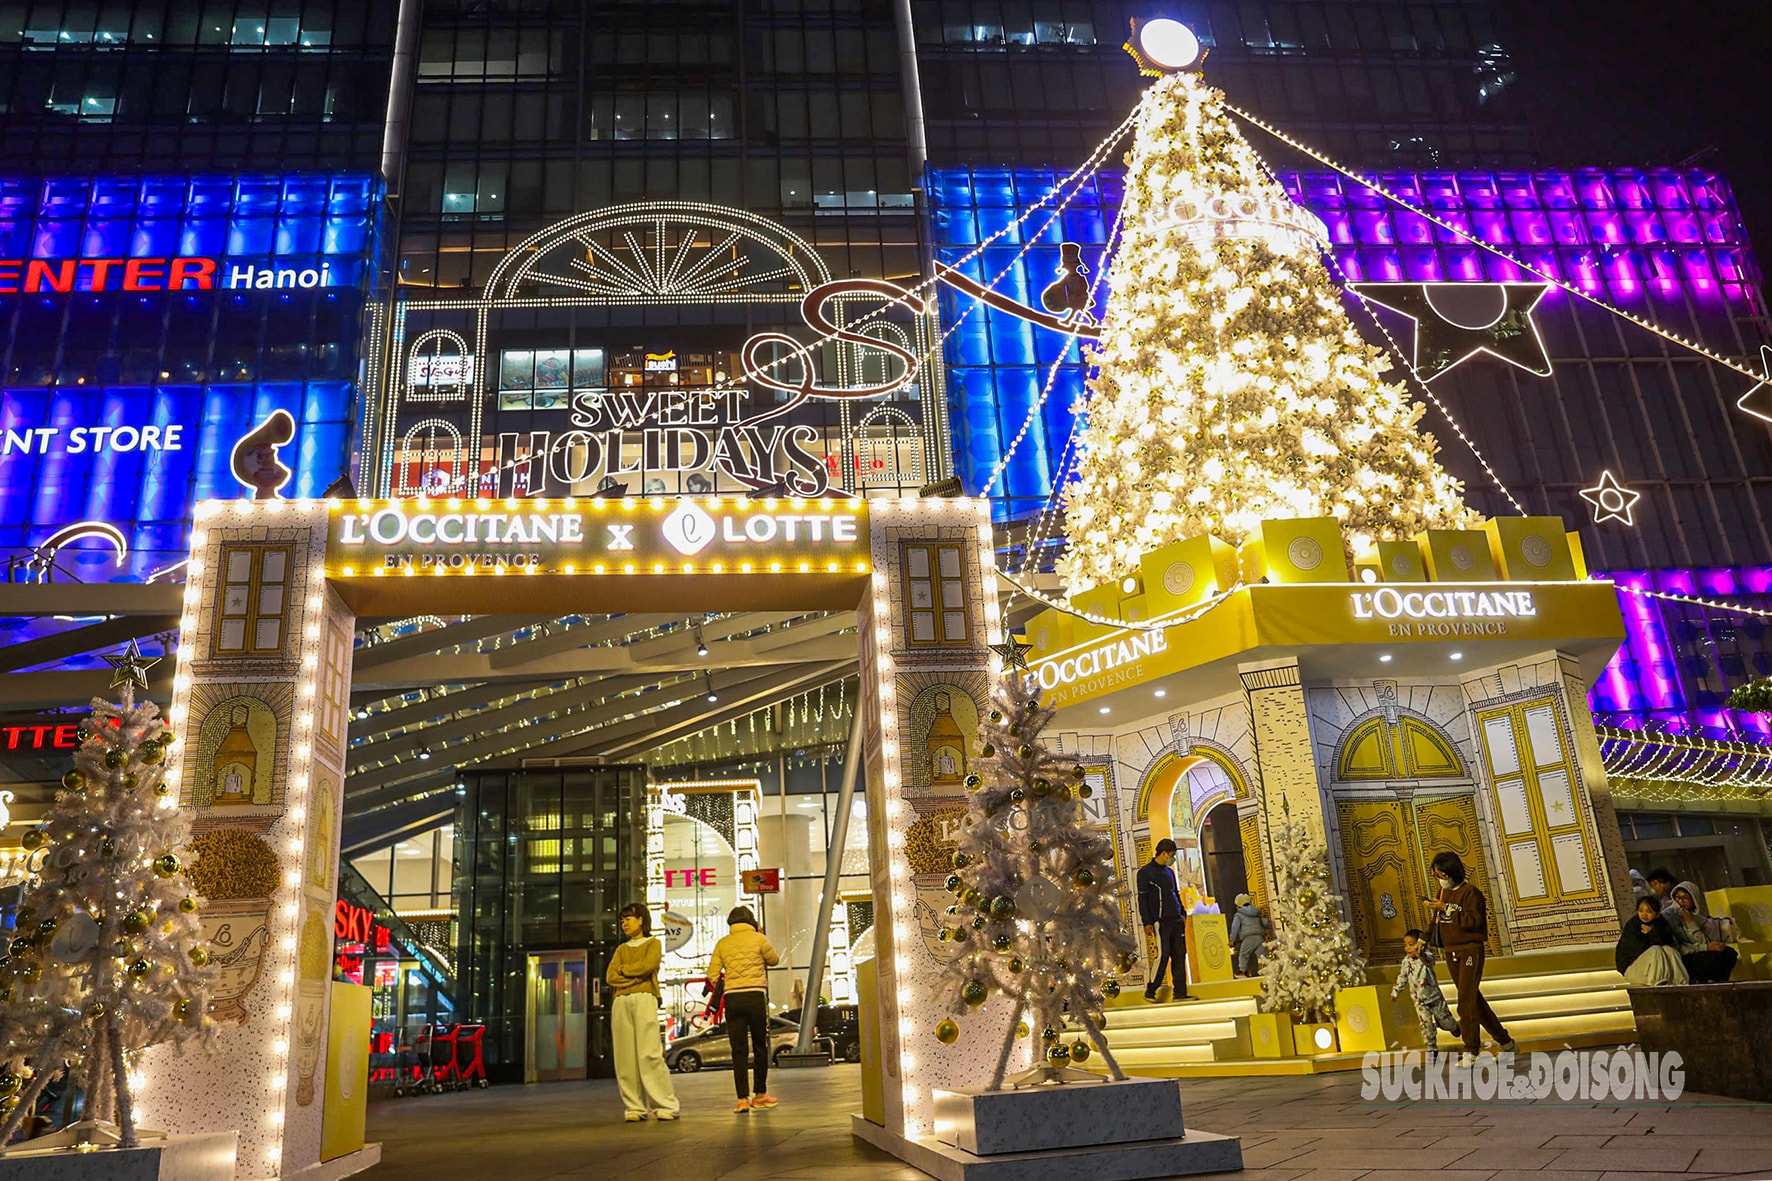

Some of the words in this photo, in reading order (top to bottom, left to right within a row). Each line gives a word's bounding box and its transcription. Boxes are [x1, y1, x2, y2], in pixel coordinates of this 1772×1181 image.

[231, 263, 330, 289] Hanoi
[571, 390, 749, 427] SWEET
[66, 425, 183, 454] STORE
[497, 425, 829, 498] HOLIDAYS
[340, 509, 583, 544] L'OCCITANE
[723, 515, 857, 542] LOTTE
[384, 554, 413, 568] EN
[422, 553, 539, 569] PROVENCE
[1350, 588, 1536, 618] L'OCCITANE
[1389, 624, 1412, 636] EN
[1418, 622, 1507, 636] PROVENCE
[1071, 664, 1144, 698] PROVENCE
[335, 899, 374, 943] SKY
